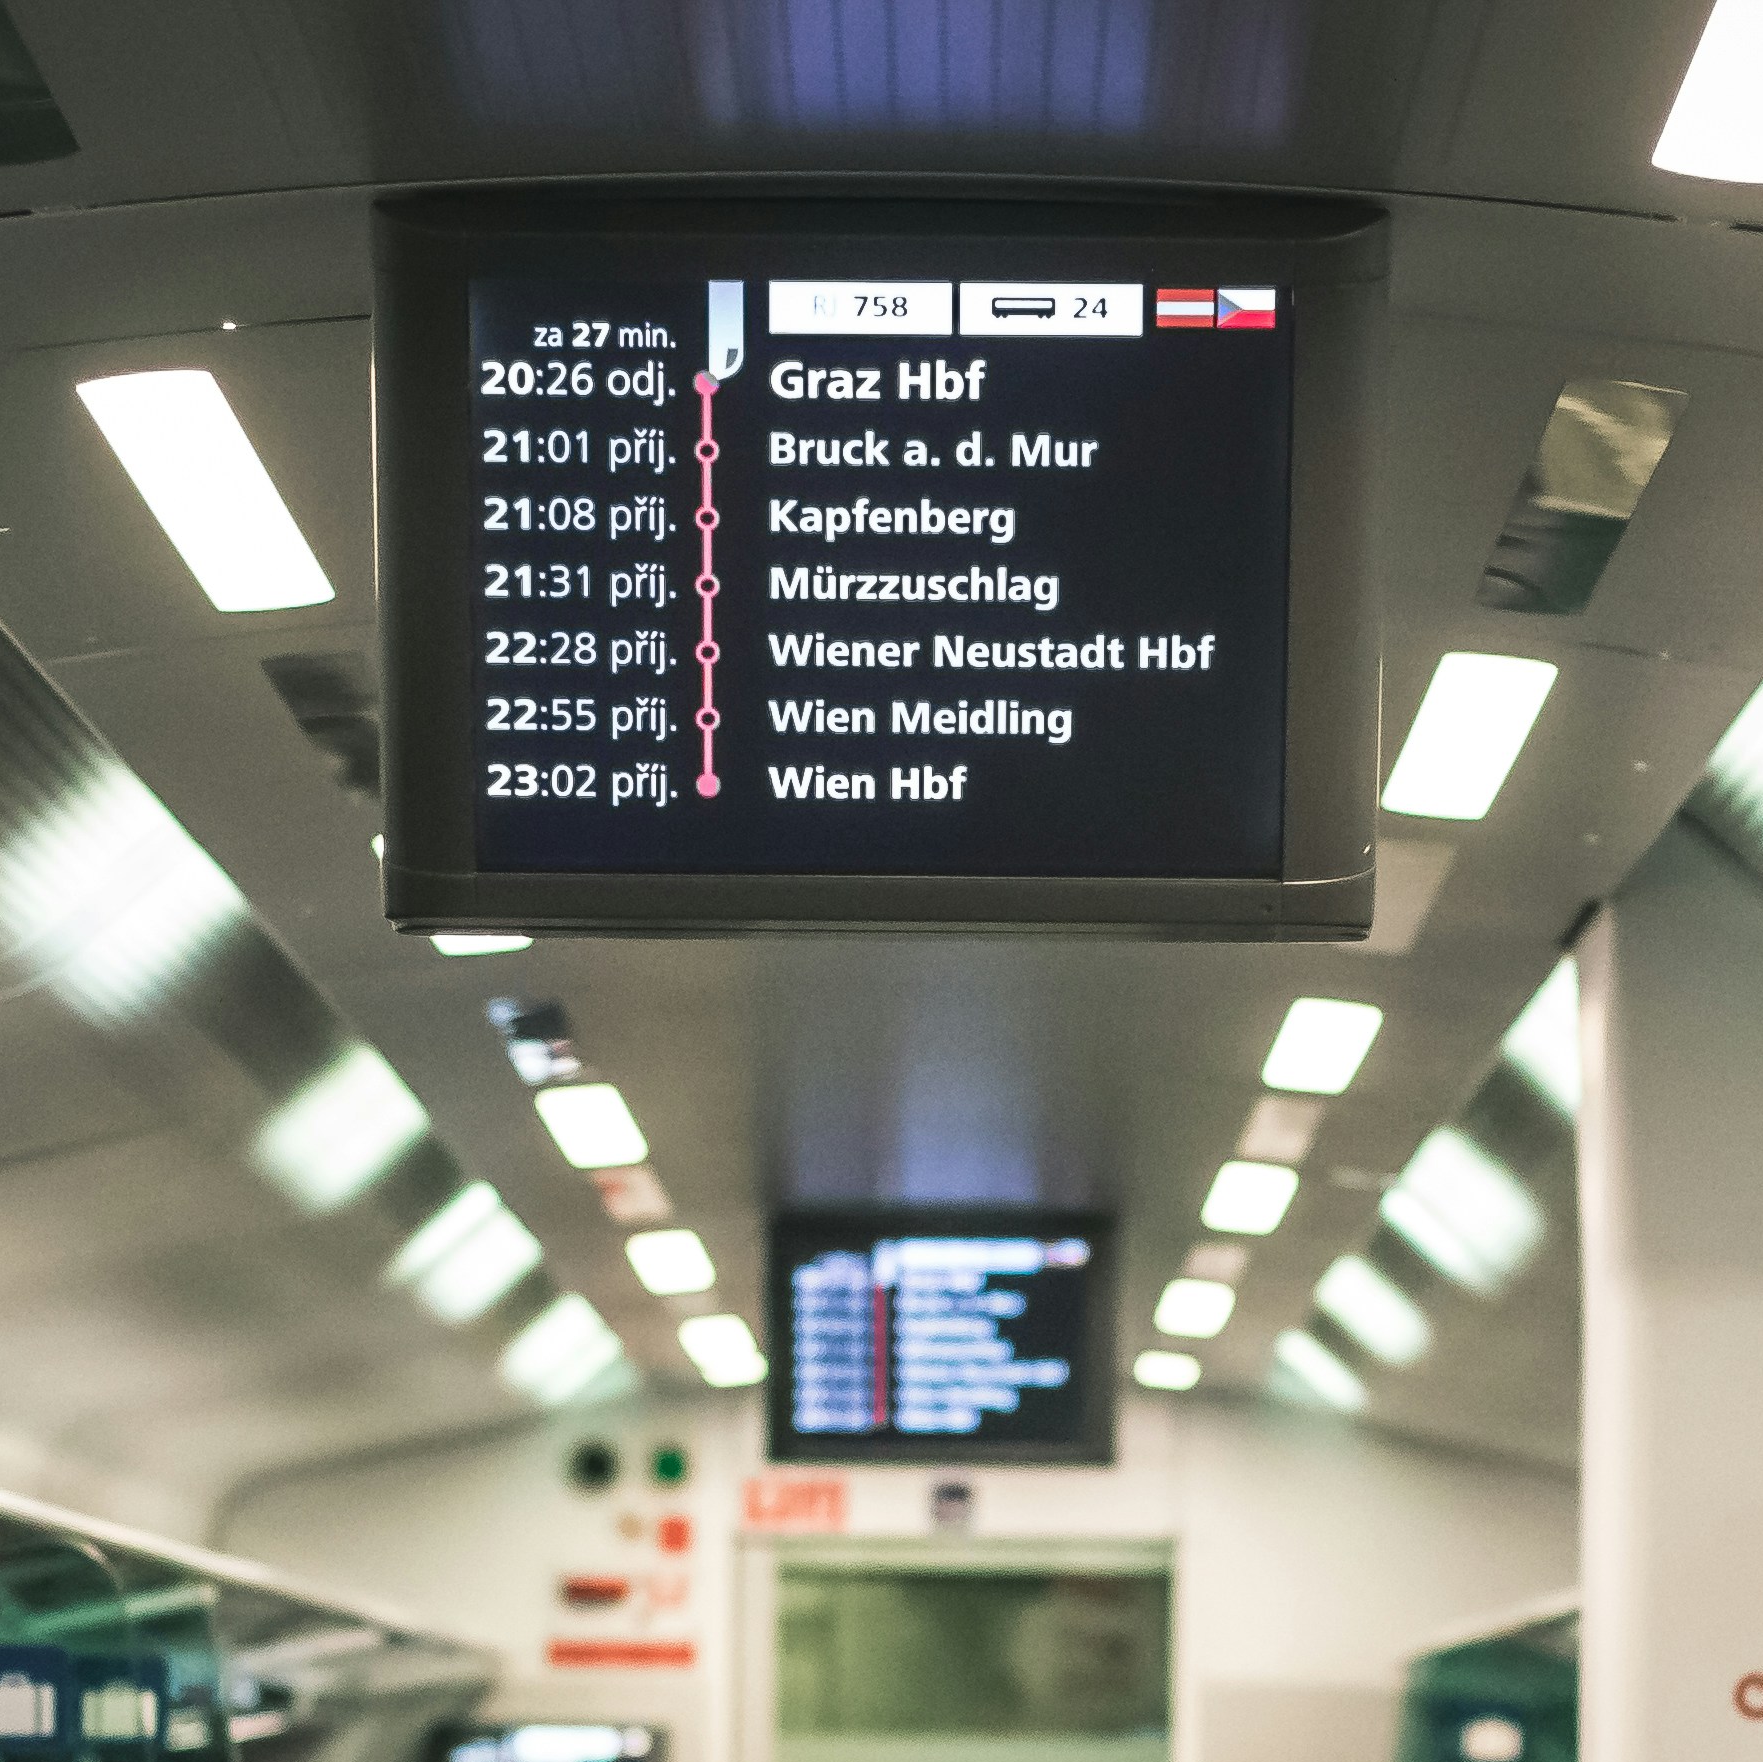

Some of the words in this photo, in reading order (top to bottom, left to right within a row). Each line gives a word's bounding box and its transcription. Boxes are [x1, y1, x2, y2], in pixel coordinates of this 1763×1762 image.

[853, 295, 909, 318] 758
[1072, 296, 1108, 319] 24
[533, 327, 563, 348] za
[572, 320, 611, 348] 27
[618, 320, 676, 348] min.
[481, 360, 595, 397] 20:26
[606, 360, 676, 407] odj.
[769, 360, 882, 402] Graz
[897, 359, 987, 402] Hbf
[483, 428, 590, 464] 21:01
[609, 427, 676, 475] příj.
[769, 429, 891, 468] Bruck
[902, 440, 941, 468] a.
[956, 431, 996, 468] d.
[1011, 432, 1099, 468] Mur
[484, 495, 596, 531] 21:08
[609, 495, 676, 542] příj.
[768, 496, 1016, 544] Kapfenberg
[484, 563, 591, 599] 21:31
[610, 563, 676, 609] příj.
[769, 564, 1060, 612] Mürzzuschlag
[485, 631, 597, 667] 22:28
[611, 630, 676, 676] příj.
[768, 632, 920, 669] Wiener
[933, 633, 1125, 671] Neustadt
[1138, 633, 1216, 671] Hbf
[485, 696, 597, 732] 22:55
[612, 697, 677, 742] příj.
[768, 698, 876, 735] Wien
[891, 699, 1073, 746] Meidling
[486, 763, 597, 799] 23:02
[612, 763, 678, 808] příj.
[768, 764, 876, 800] Wien
[890, 764, 969, 802] Hbf
